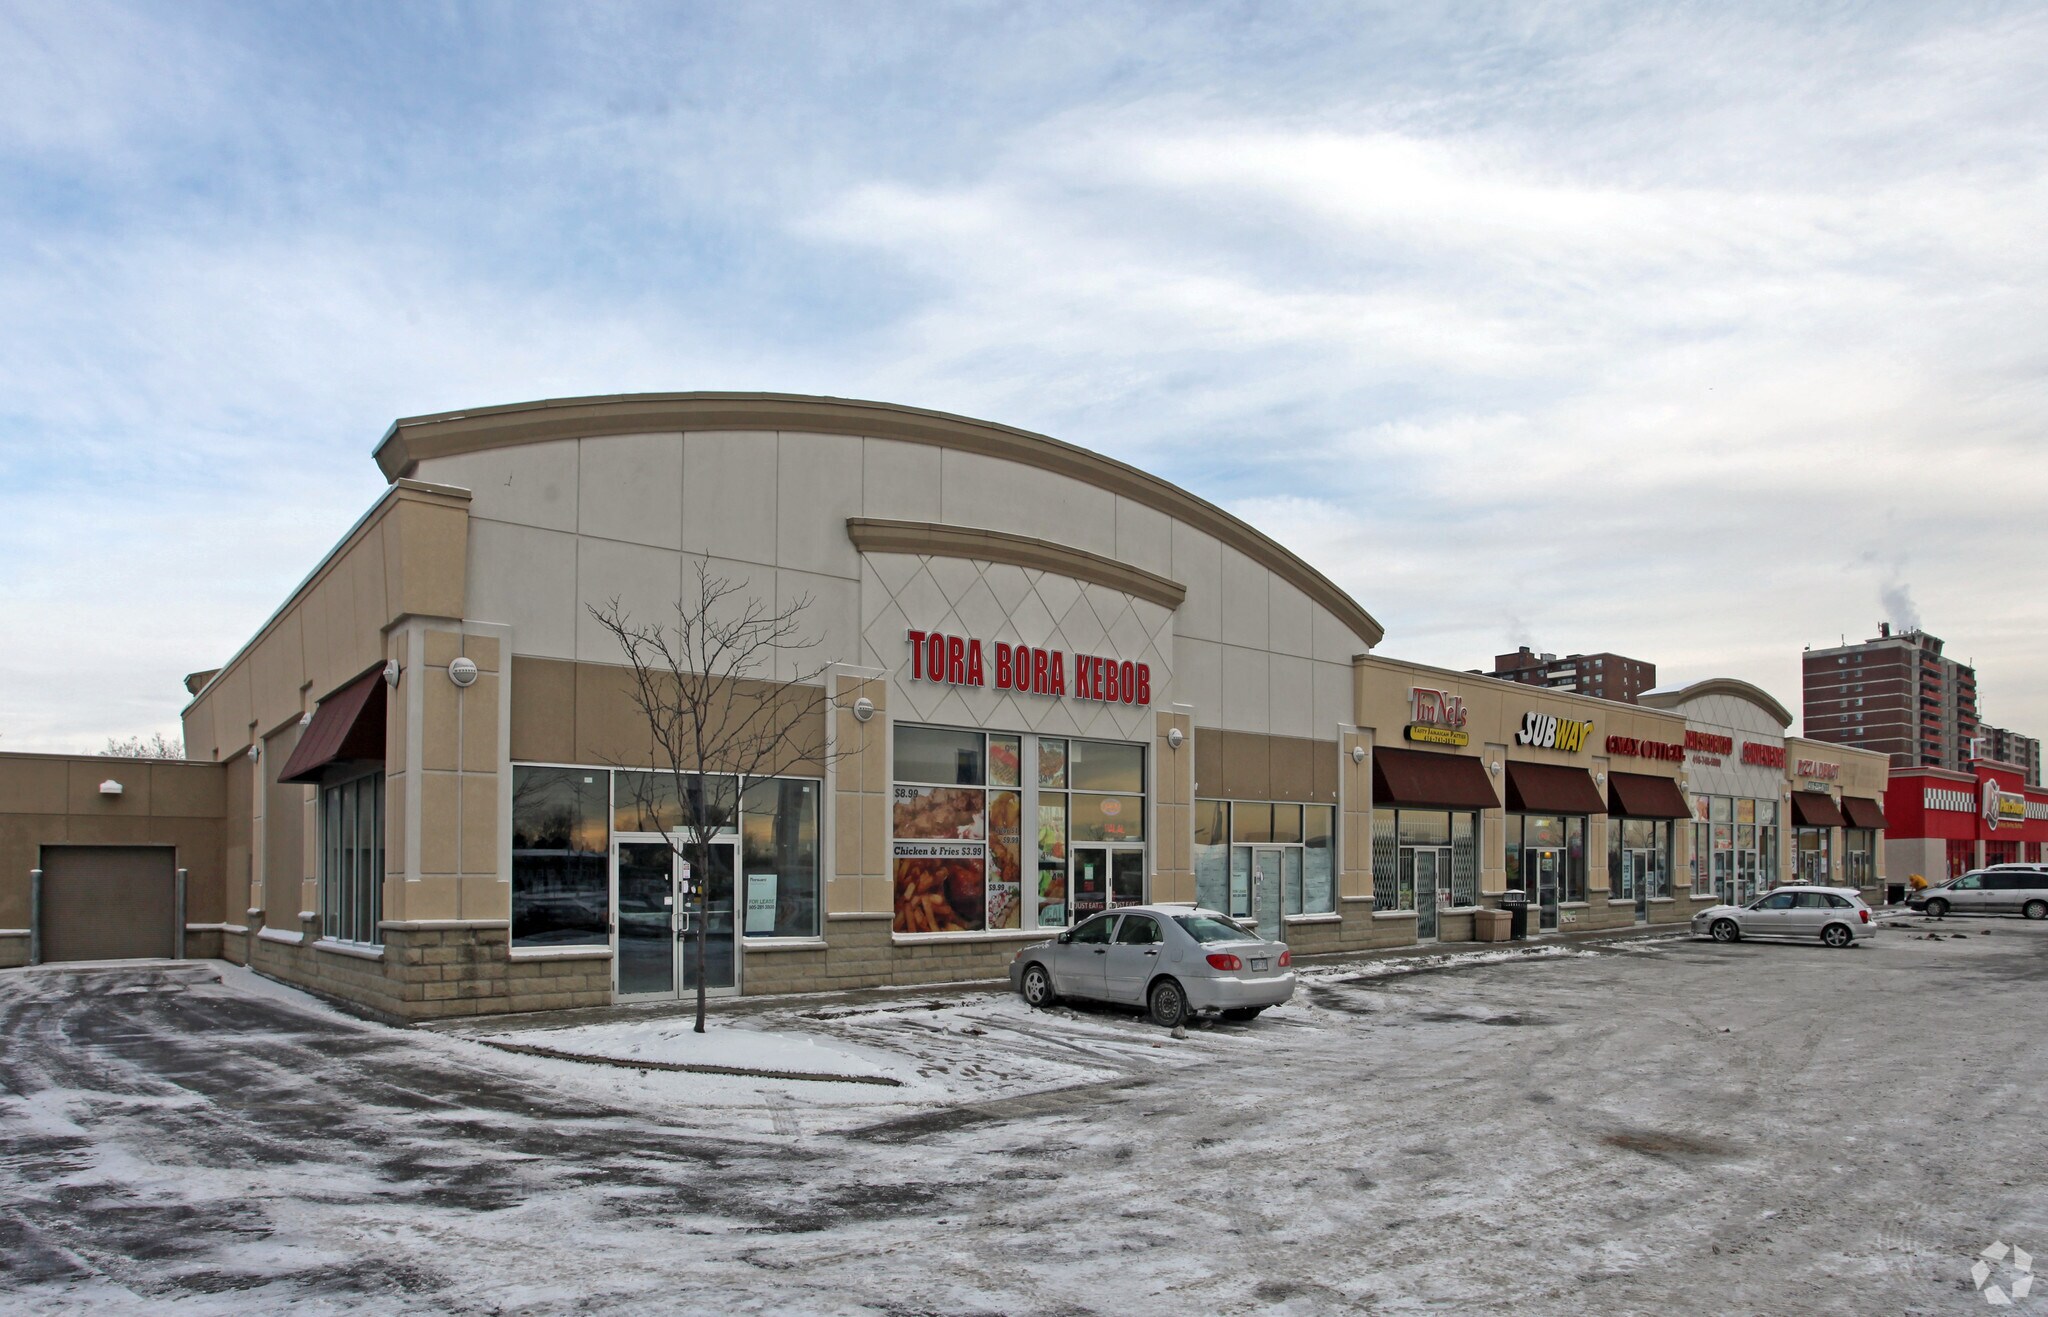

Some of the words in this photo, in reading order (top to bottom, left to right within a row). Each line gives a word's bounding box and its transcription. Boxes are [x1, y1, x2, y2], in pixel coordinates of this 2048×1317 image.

[906, 628, 985, 687] TORA
[994, 640, 1066, 697] BORA
[1073, 652, 1151, 706] KEBOB
[1516, 711, 1595, 753] SUBWAY
[1641, 740, 1686, 762] OPTICAL
[1743, 741, 1787, 768] CONVENIENCE
[1797, 759, 1817, 778] PIZZA
[1819, 762, 1840, 780] DEPOT
[894, 788, 919, 798] $8.99
[894, 846, 928, 856] Chicken
[930, 847, 937, 855] &
[939, 847, 960, 856] Fries
[962, 847, 982, 856] $3.99
[988, 883, 1005, 892] $9.99
